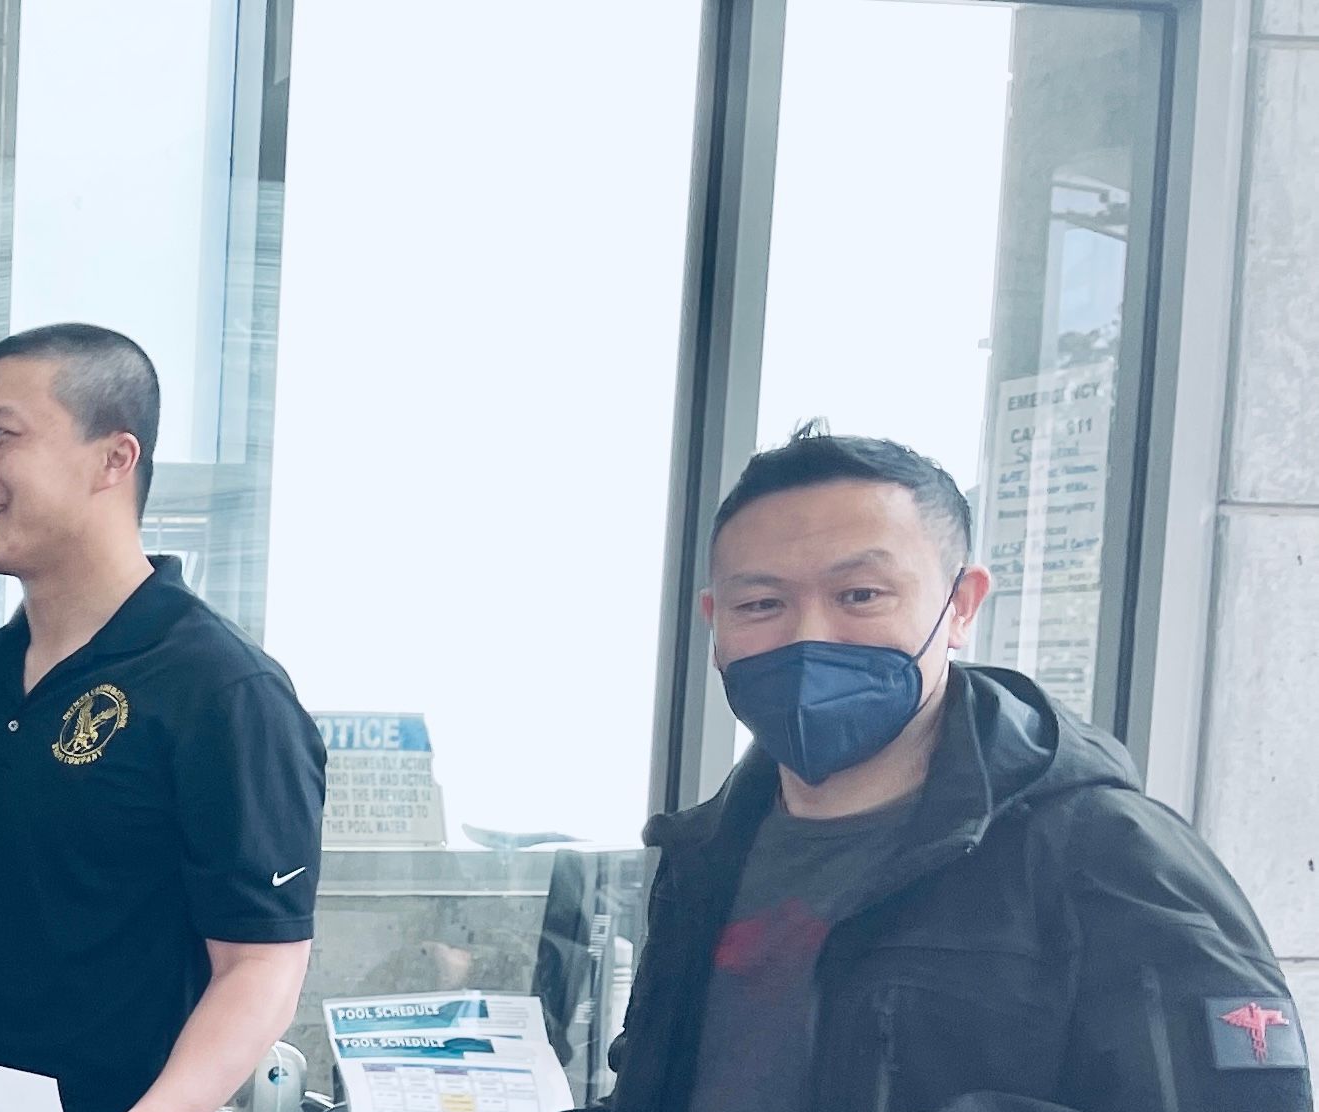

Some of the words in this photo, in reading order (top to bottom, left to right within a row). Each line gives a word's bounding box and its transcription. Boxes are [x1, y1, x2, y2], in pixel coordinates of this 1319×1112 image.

[1007, 382, 1101, 411] EMERGNCY
[316, 718, 401, 749] OTICE
[400, 757, 432, 771] ACTIVE
[352, 774, 377, 786] HAVE
[380, 774, 399, 786] HAD
[401, 774, 433, 787] ACTIVE
[352, 788, 370, 801] THE
[372, 789, 418, 802] PREVIOUS
[331, 804, 350, 817] NOT
[354, 805, 366, 817] BE
[369, 805, 414, 818] ALLOWED
[416, 805, 429, 818] TO
[326, 820, 344, 833] THE
[347, 820, 373, 833] POOL
[337, 1008, 373, 1021] POOL
[376, 1004, 441, 1018] SCHEDULE
[340, 1037, 377, 1049] POOL
[379, 1038, 446, 1049] SCHEDULE
